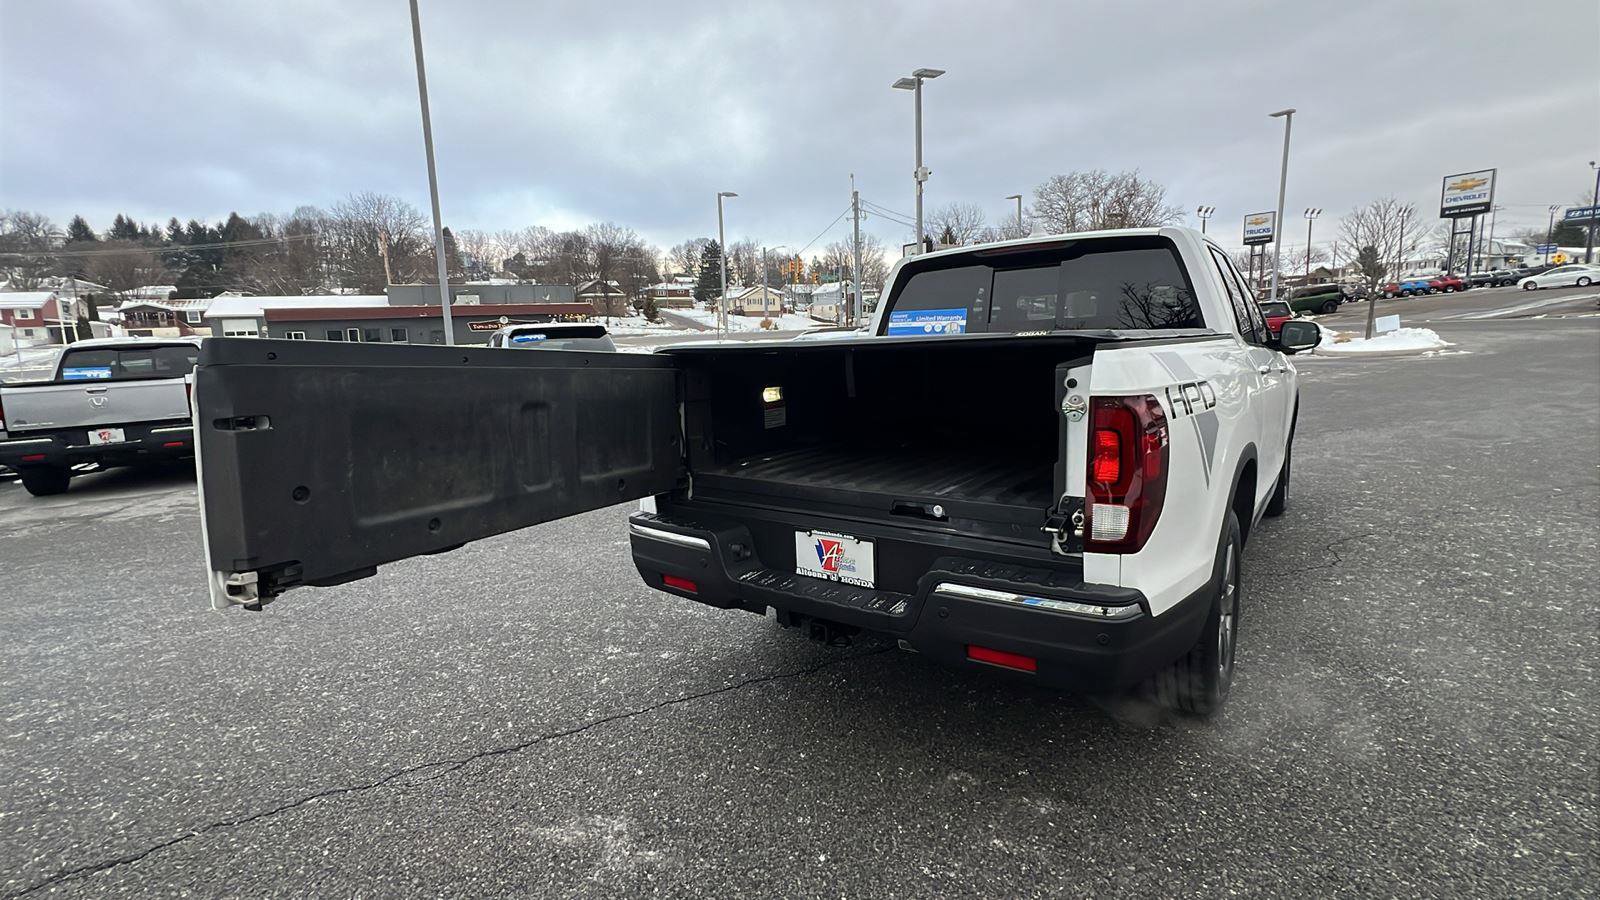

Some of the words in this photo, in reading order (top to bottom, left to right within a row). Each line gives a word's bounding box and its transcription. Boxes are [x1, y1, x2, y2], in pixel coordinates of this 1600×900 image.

[1445, 193, 1488, 203] CHEVROLET
[1246, 227, 1271, 235] TRUCKS
[1165, 381, 1216, 419] HPD
[796, 567, 828, 579] Altoona
[841, 576, 875, 589] HONDA
